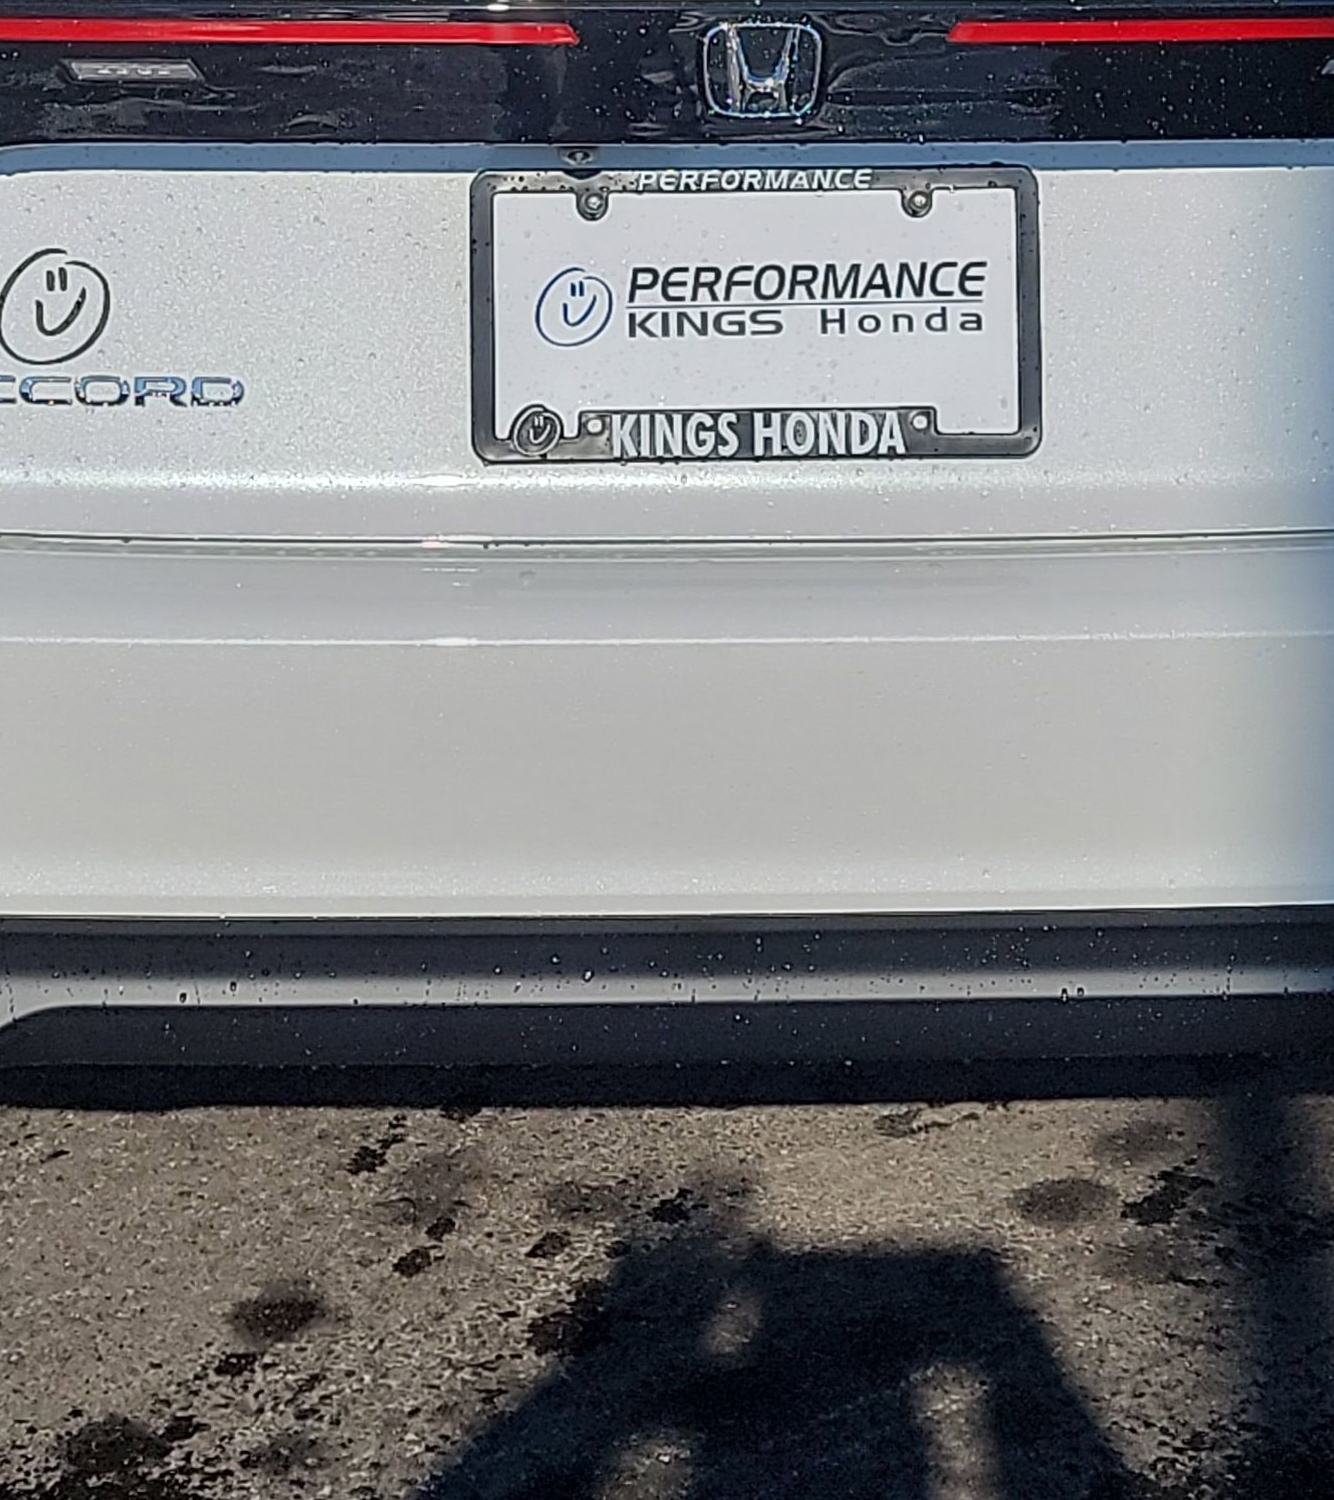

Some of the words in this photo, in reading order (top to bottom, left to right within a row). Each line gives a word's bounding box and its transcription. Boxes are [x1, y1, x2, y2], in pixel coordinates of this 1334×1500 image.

[637, 168, 873, 192] PERFORMANCE
[627, 261, 987, 304] PERFORMANCE
[628, 309, 784, 338] KINGS
[820, 306, 984, 335] Honda
[611, 412, 740, 459] KINGS
[752, 411, 907, 457] HONDA
